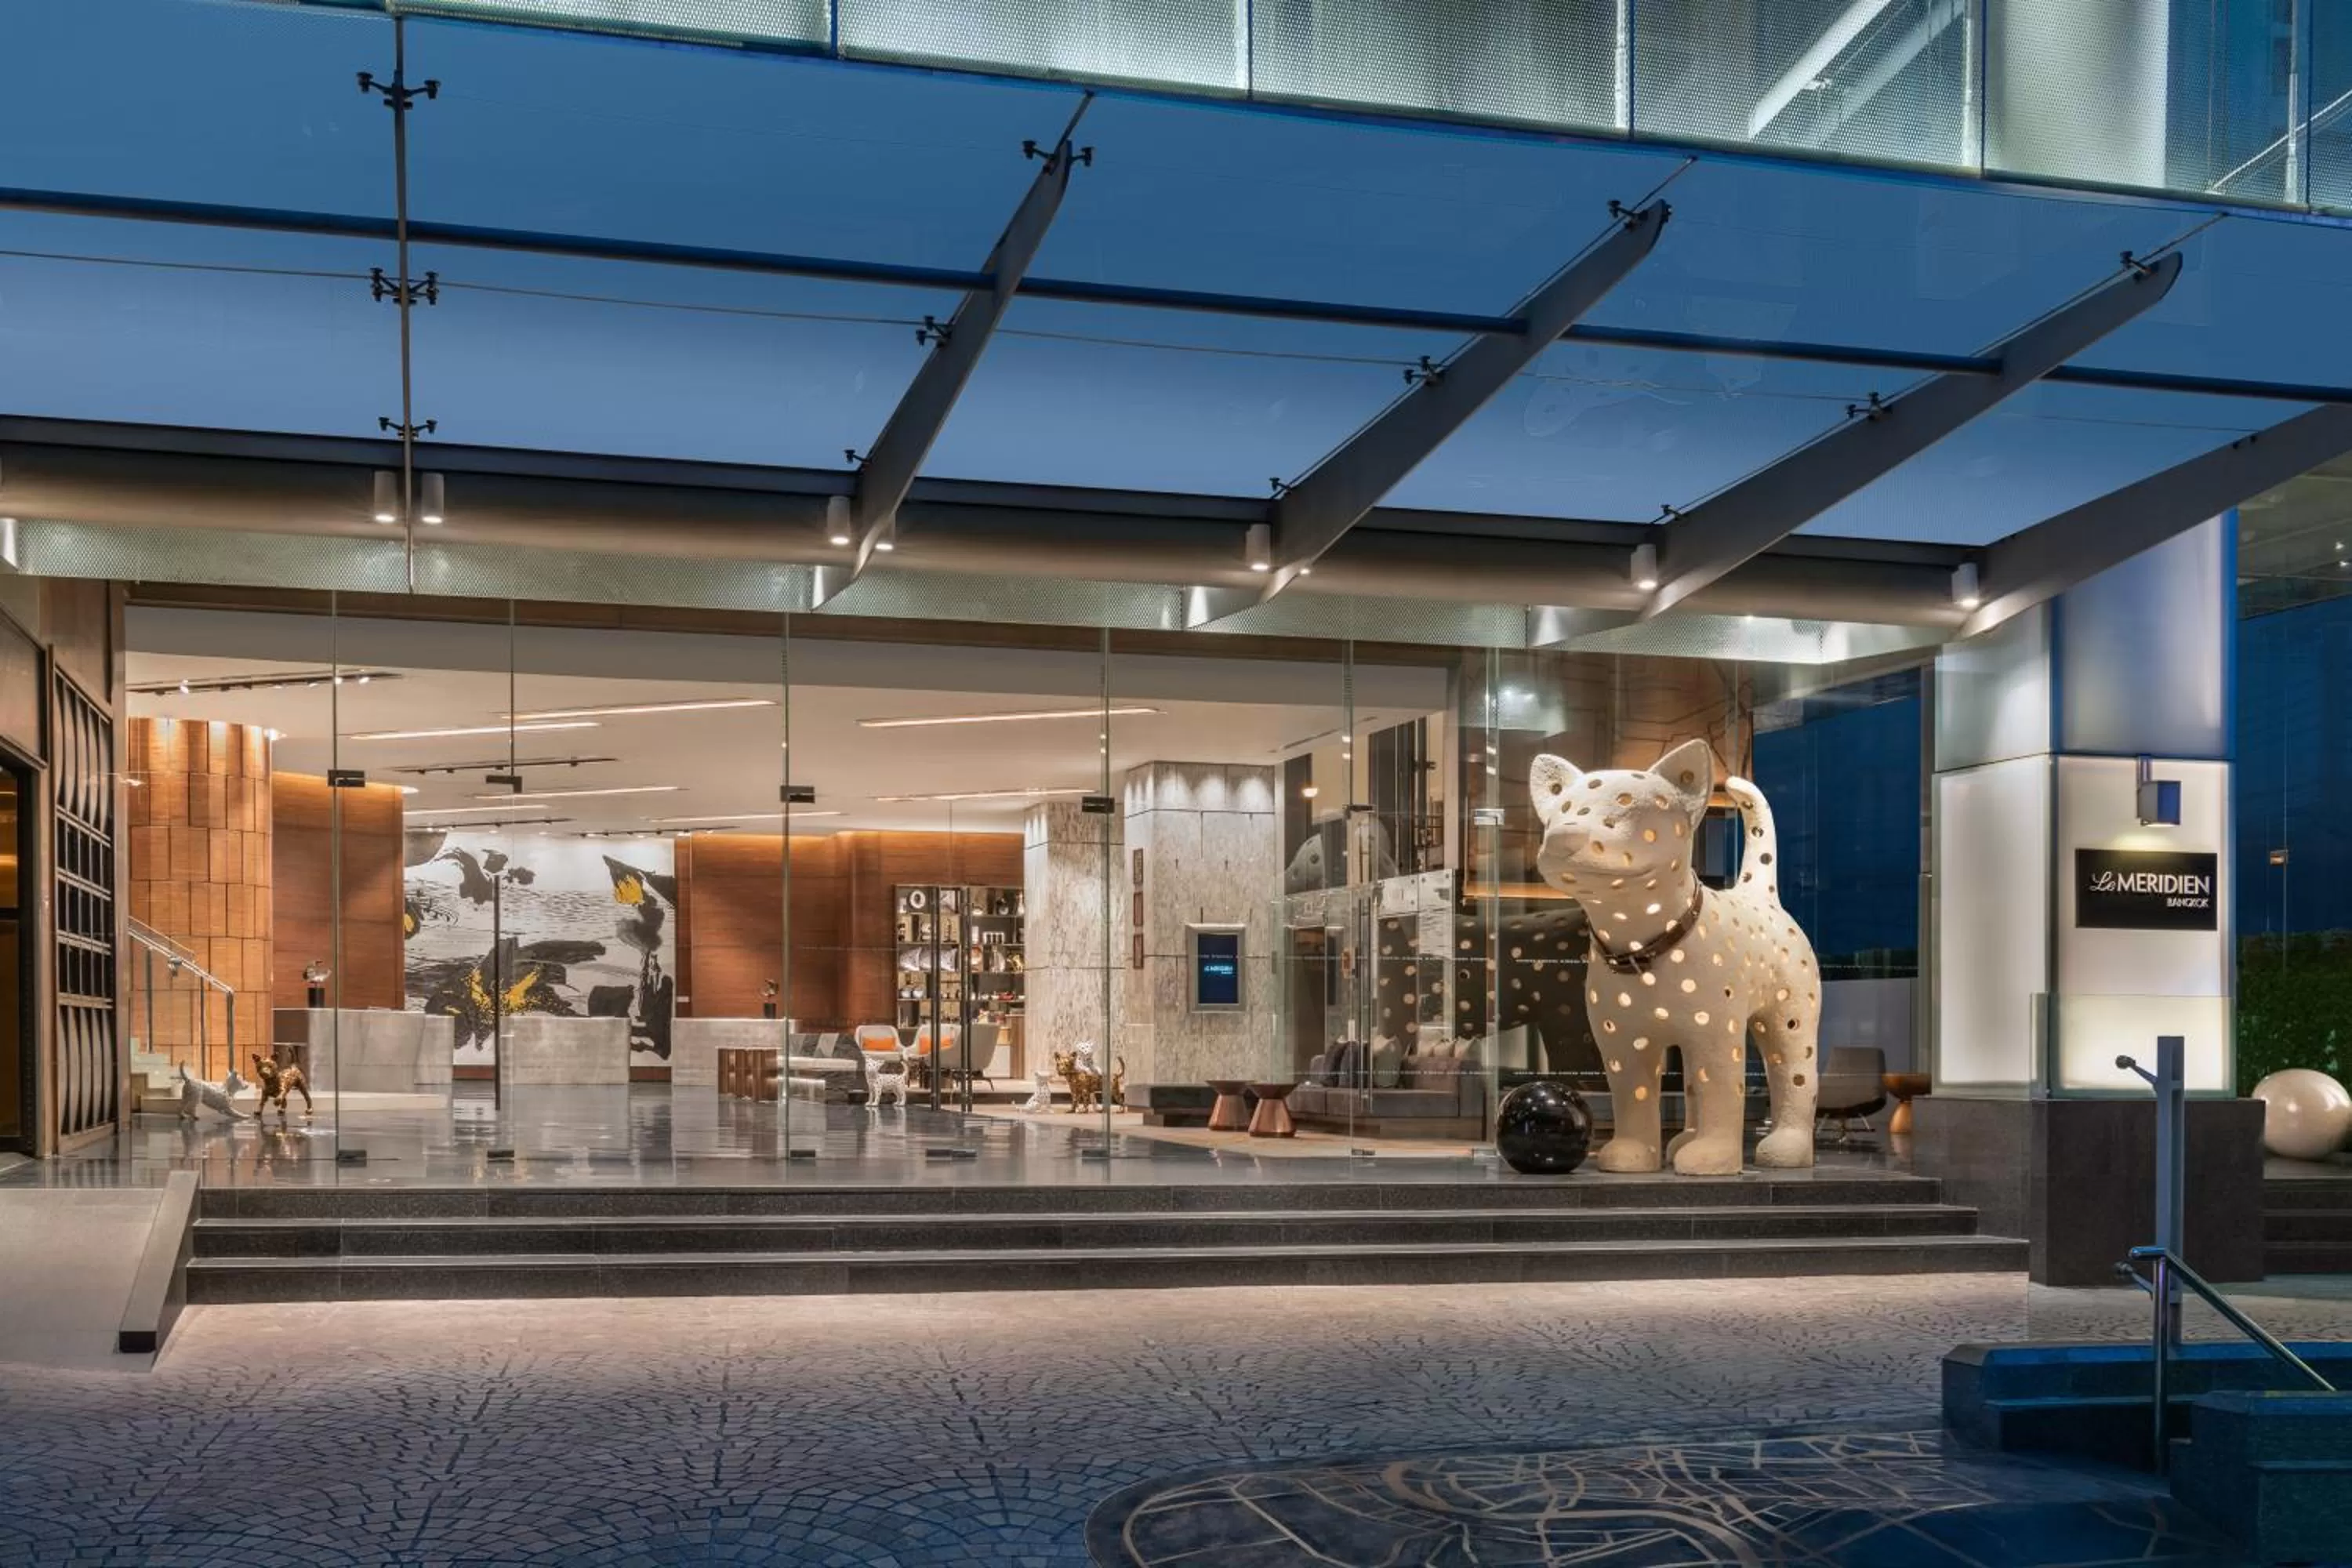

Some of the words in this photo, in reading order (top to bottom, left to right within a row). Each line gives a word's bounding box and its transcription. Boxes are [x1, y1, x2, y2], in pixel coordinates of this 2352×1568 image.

[2089, 871, 2115, 891] Le
[2117, 873, 2210, 895] MERIDIEN
[2166, 898, 2209, 908] BANGKOK
